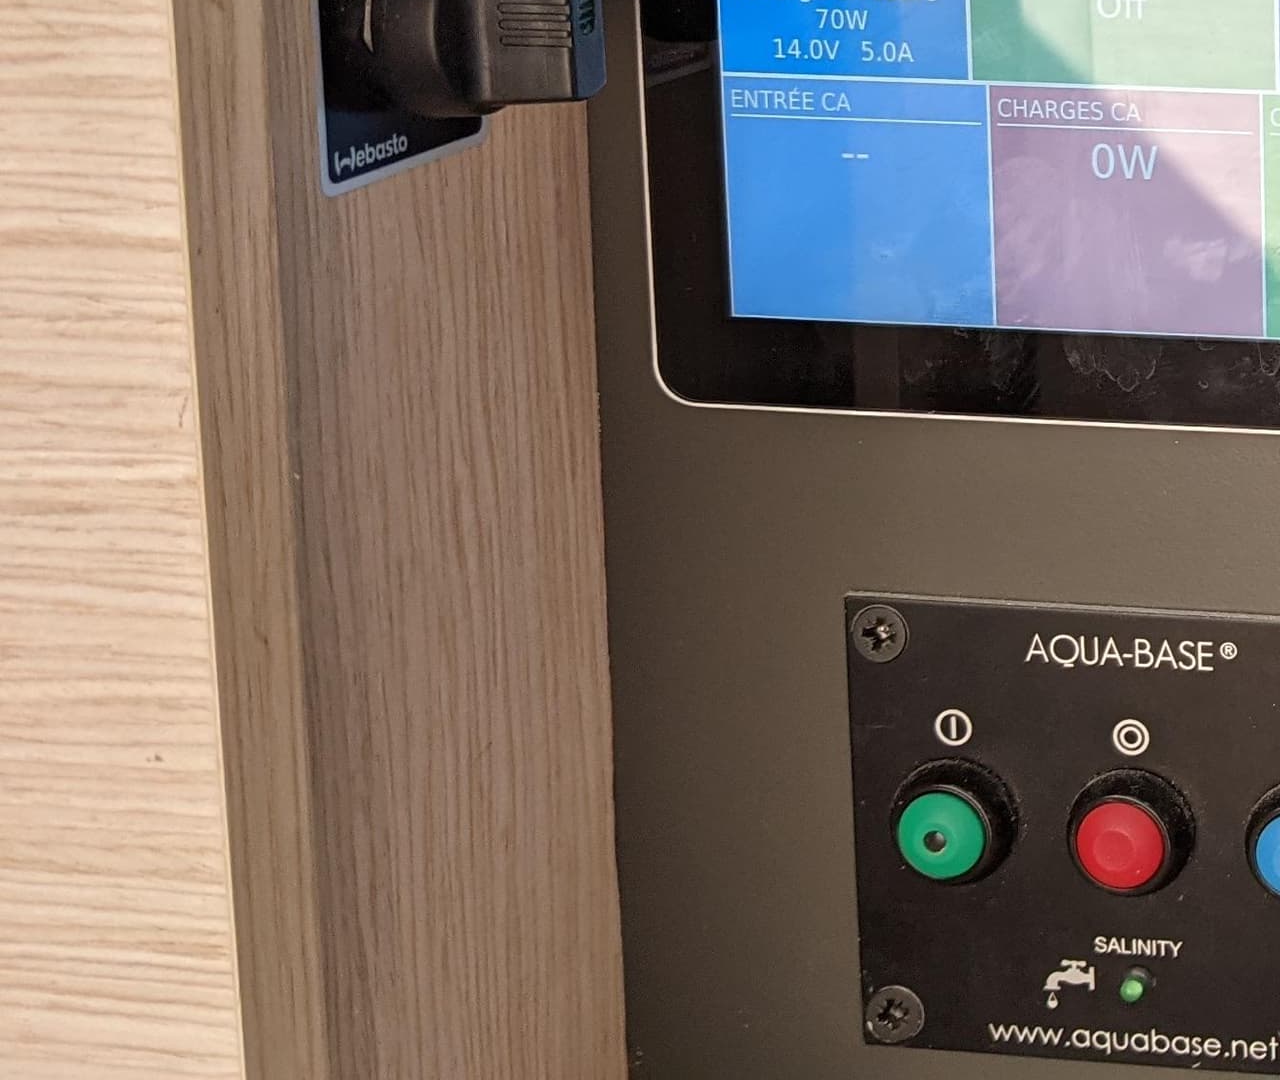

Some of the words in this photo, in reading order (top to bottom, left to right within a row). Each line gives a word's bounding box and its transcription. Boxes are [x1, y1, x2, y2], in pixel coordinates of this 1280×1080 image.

[815, 8, 868, 31] 70W
[772, 38, 840, 61] 14.0V
[861, 40, 914, 62] 5.0A
[731, 87, 815, 111] ENTRÉE
[822, 92, 851, 112] CA
[997, 97, 1104, 122] CHARGES
[1110, 100, 1142, 125] CA
[1090, 142, 1157, 183] 0W
[1094, 936, 1183, 958] SALINITY
[987, 1021, 1279, 1064] www.aquabase.net
